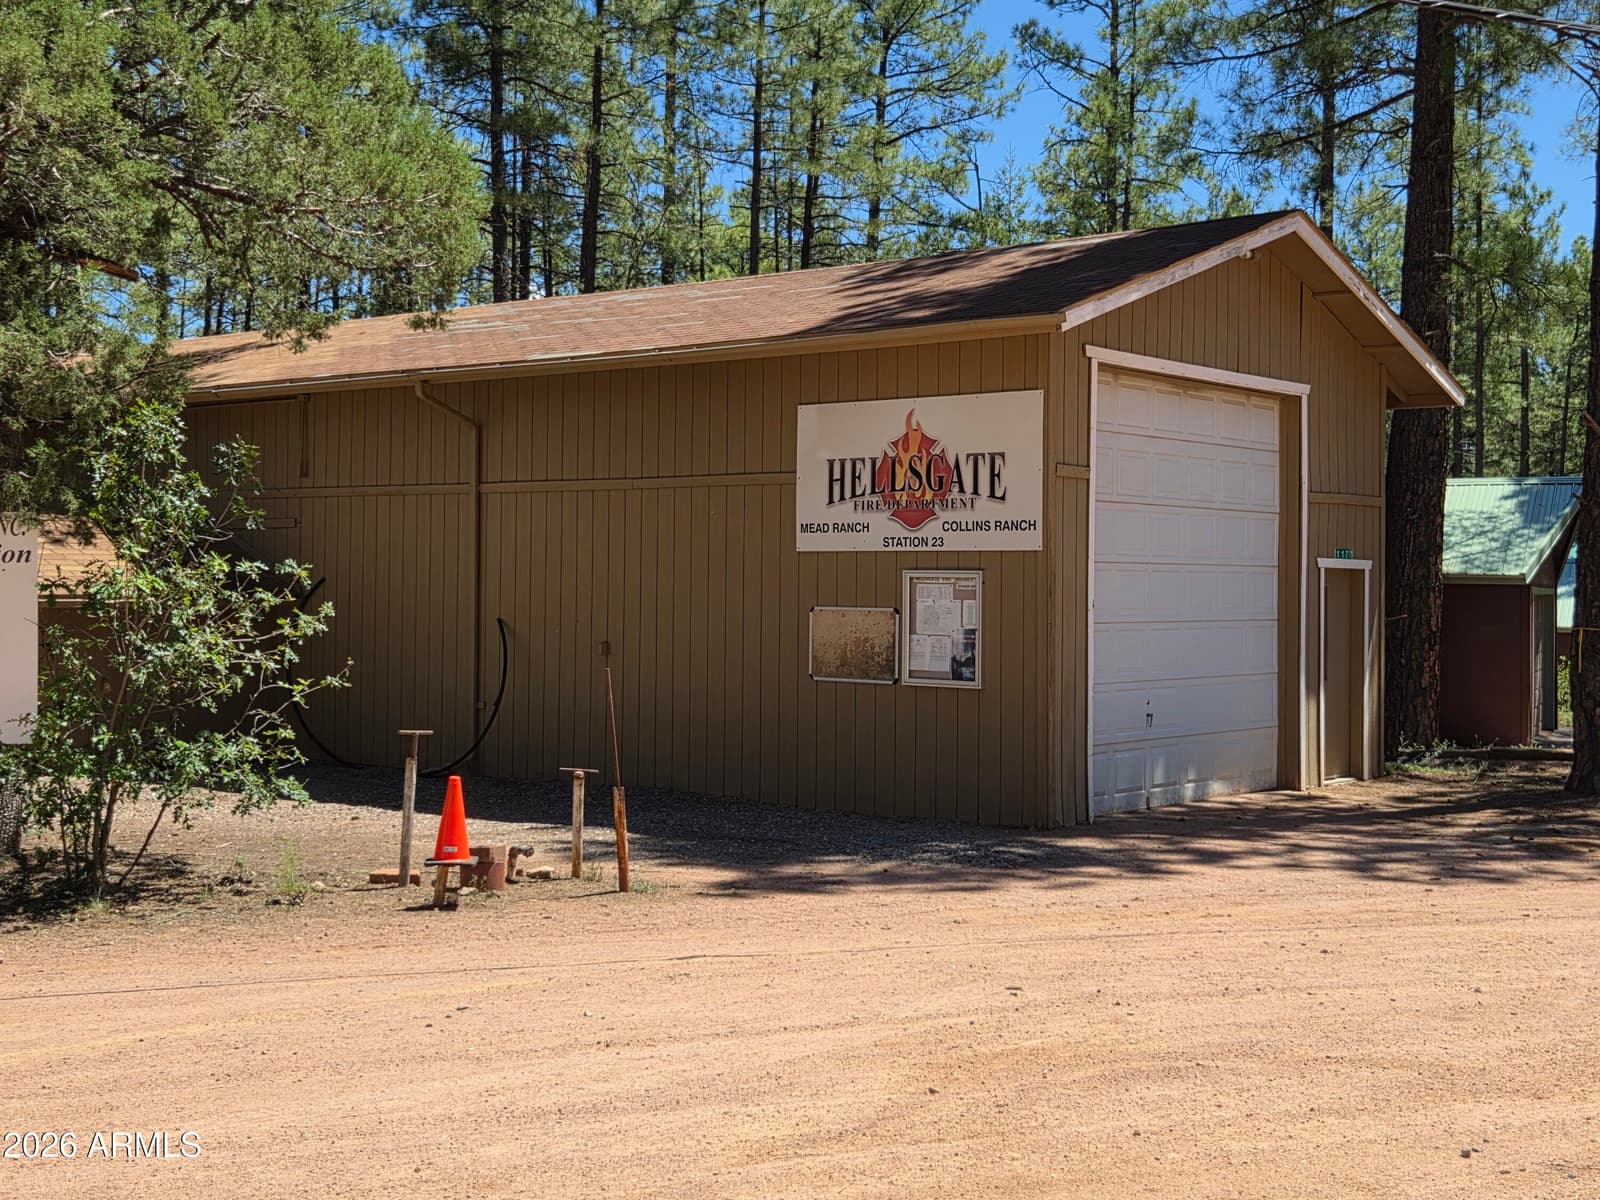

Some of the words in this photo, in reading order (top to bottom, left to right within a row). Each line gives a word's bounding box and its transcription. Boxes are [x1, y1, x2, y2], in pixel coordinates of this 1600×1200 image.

[826, 452, 1007, 506] HELLSGATE
[854, 500, 882, 512] FIRE
[887, 498, 977, 511] DEPARTMENT
[800, 523, 830, 534] MEAD
[832, 522, 870, 533] RANCH
[942, 520, 991, 532] COLLINS
[993, 520, 1037, 532] RANCH
[882, 537, 929, 548] STATION
[931, 536, 944, 548] 23
